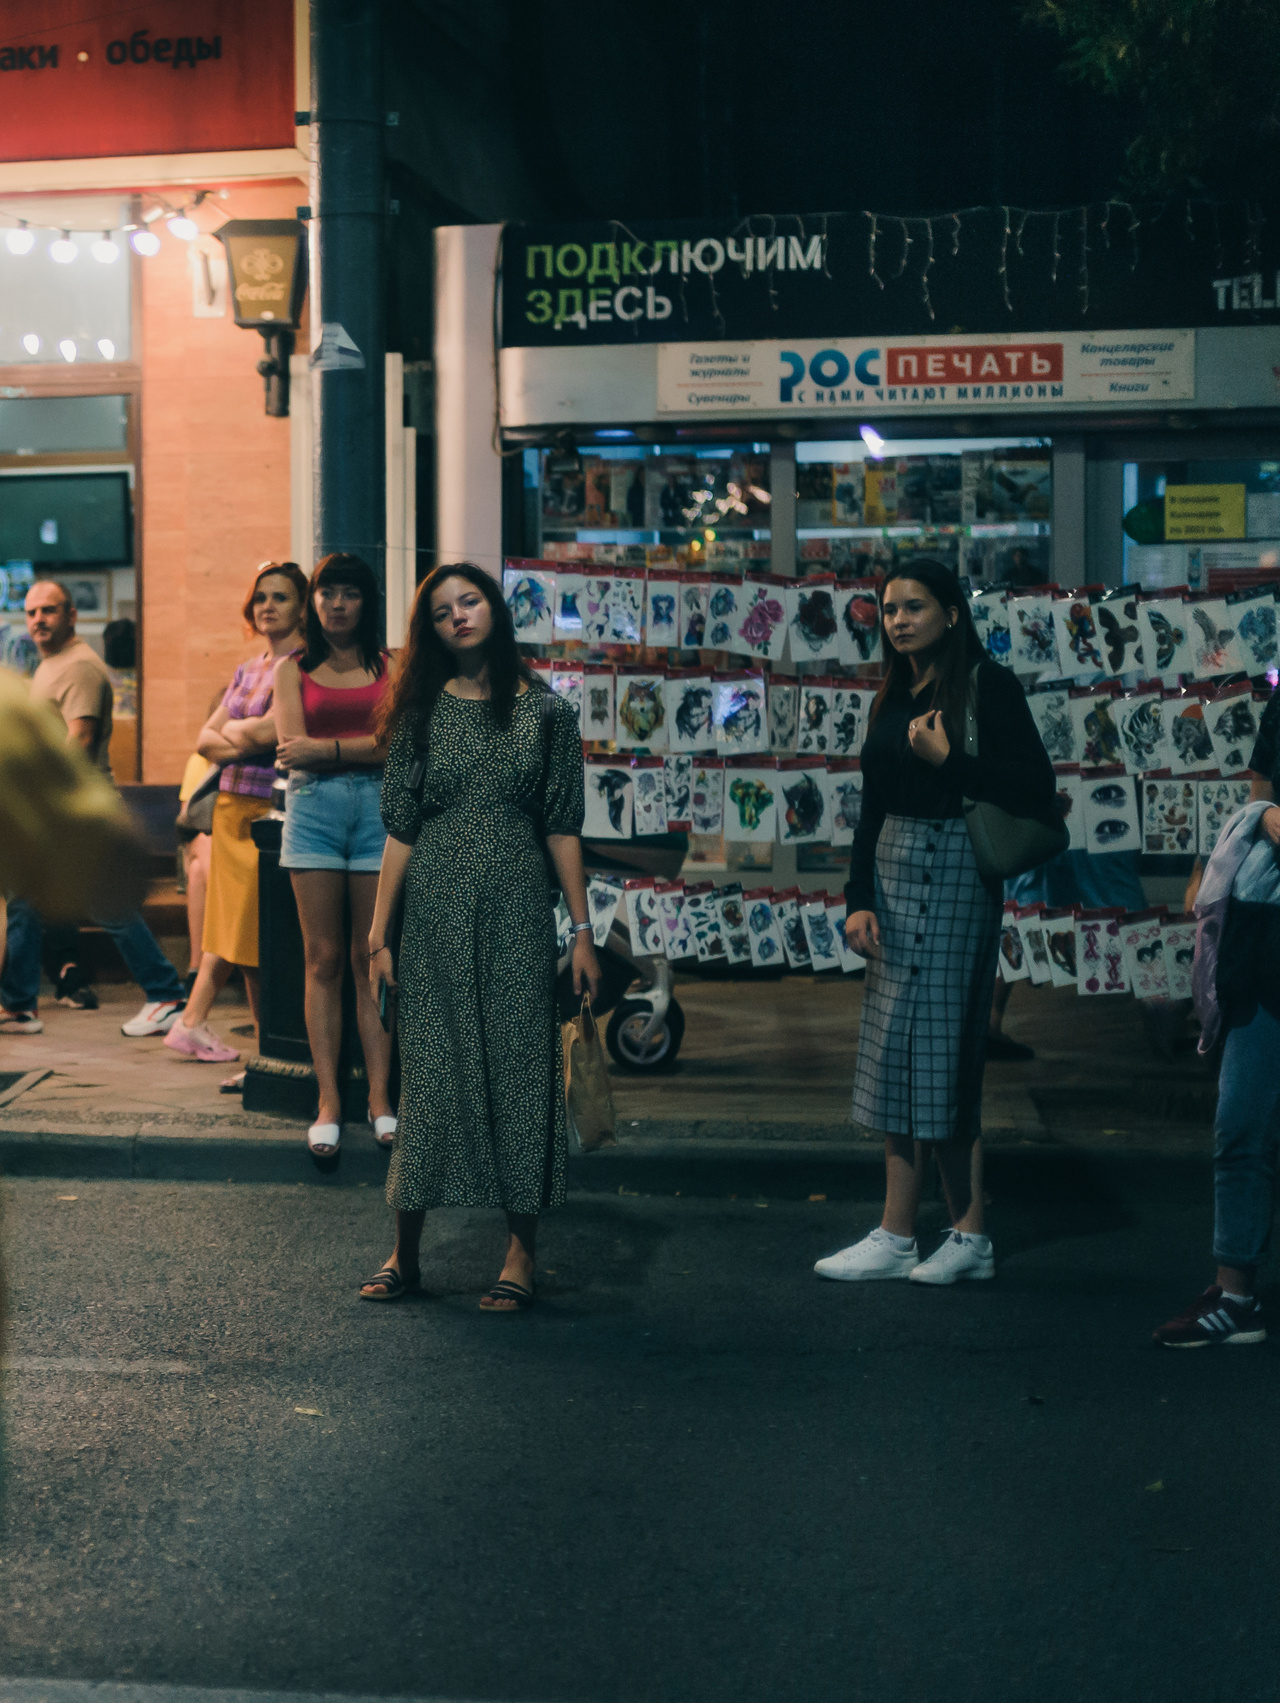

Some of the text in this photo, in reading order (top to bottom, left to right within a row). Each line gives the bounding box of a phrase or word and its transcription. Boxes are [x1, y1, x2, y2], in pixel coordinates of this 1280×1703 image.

[106, 30, 222, 69] обеды
[526, 236, 822, 284] ПОДКЛЮЧИМ
[525, 286, 673, 331] ЗДЕСЬ
[897, 351, 1052, 378] ПЕЧАТЬ
[816, 388, 866, 403] НАМИ
[875, 386, 946, 401] ЧИТАЮТ
[957, 384, 1064, 399] МИЛЛИОНЫ
[1108, 381, 1150, 394] Книги
